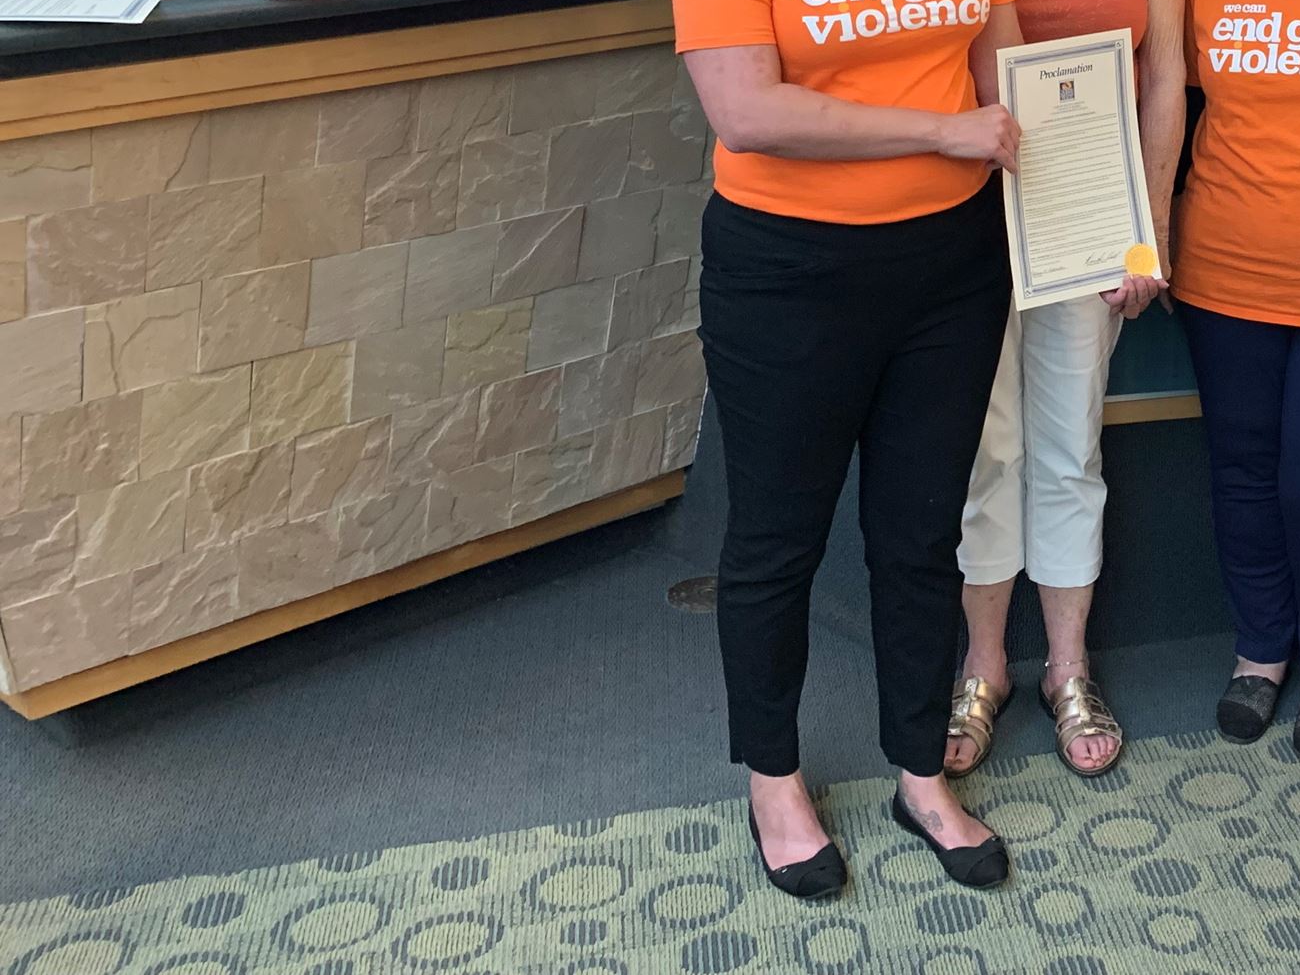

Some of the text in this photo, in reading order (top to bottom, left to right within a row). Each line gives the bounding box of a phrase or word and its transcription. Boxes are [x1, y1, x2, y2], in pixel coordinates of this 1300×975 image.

[1224, 3, 1266, 13] we can
[1213, 12, 1282, 43] end
[1039, 61, 1094, 80] Proclamation
